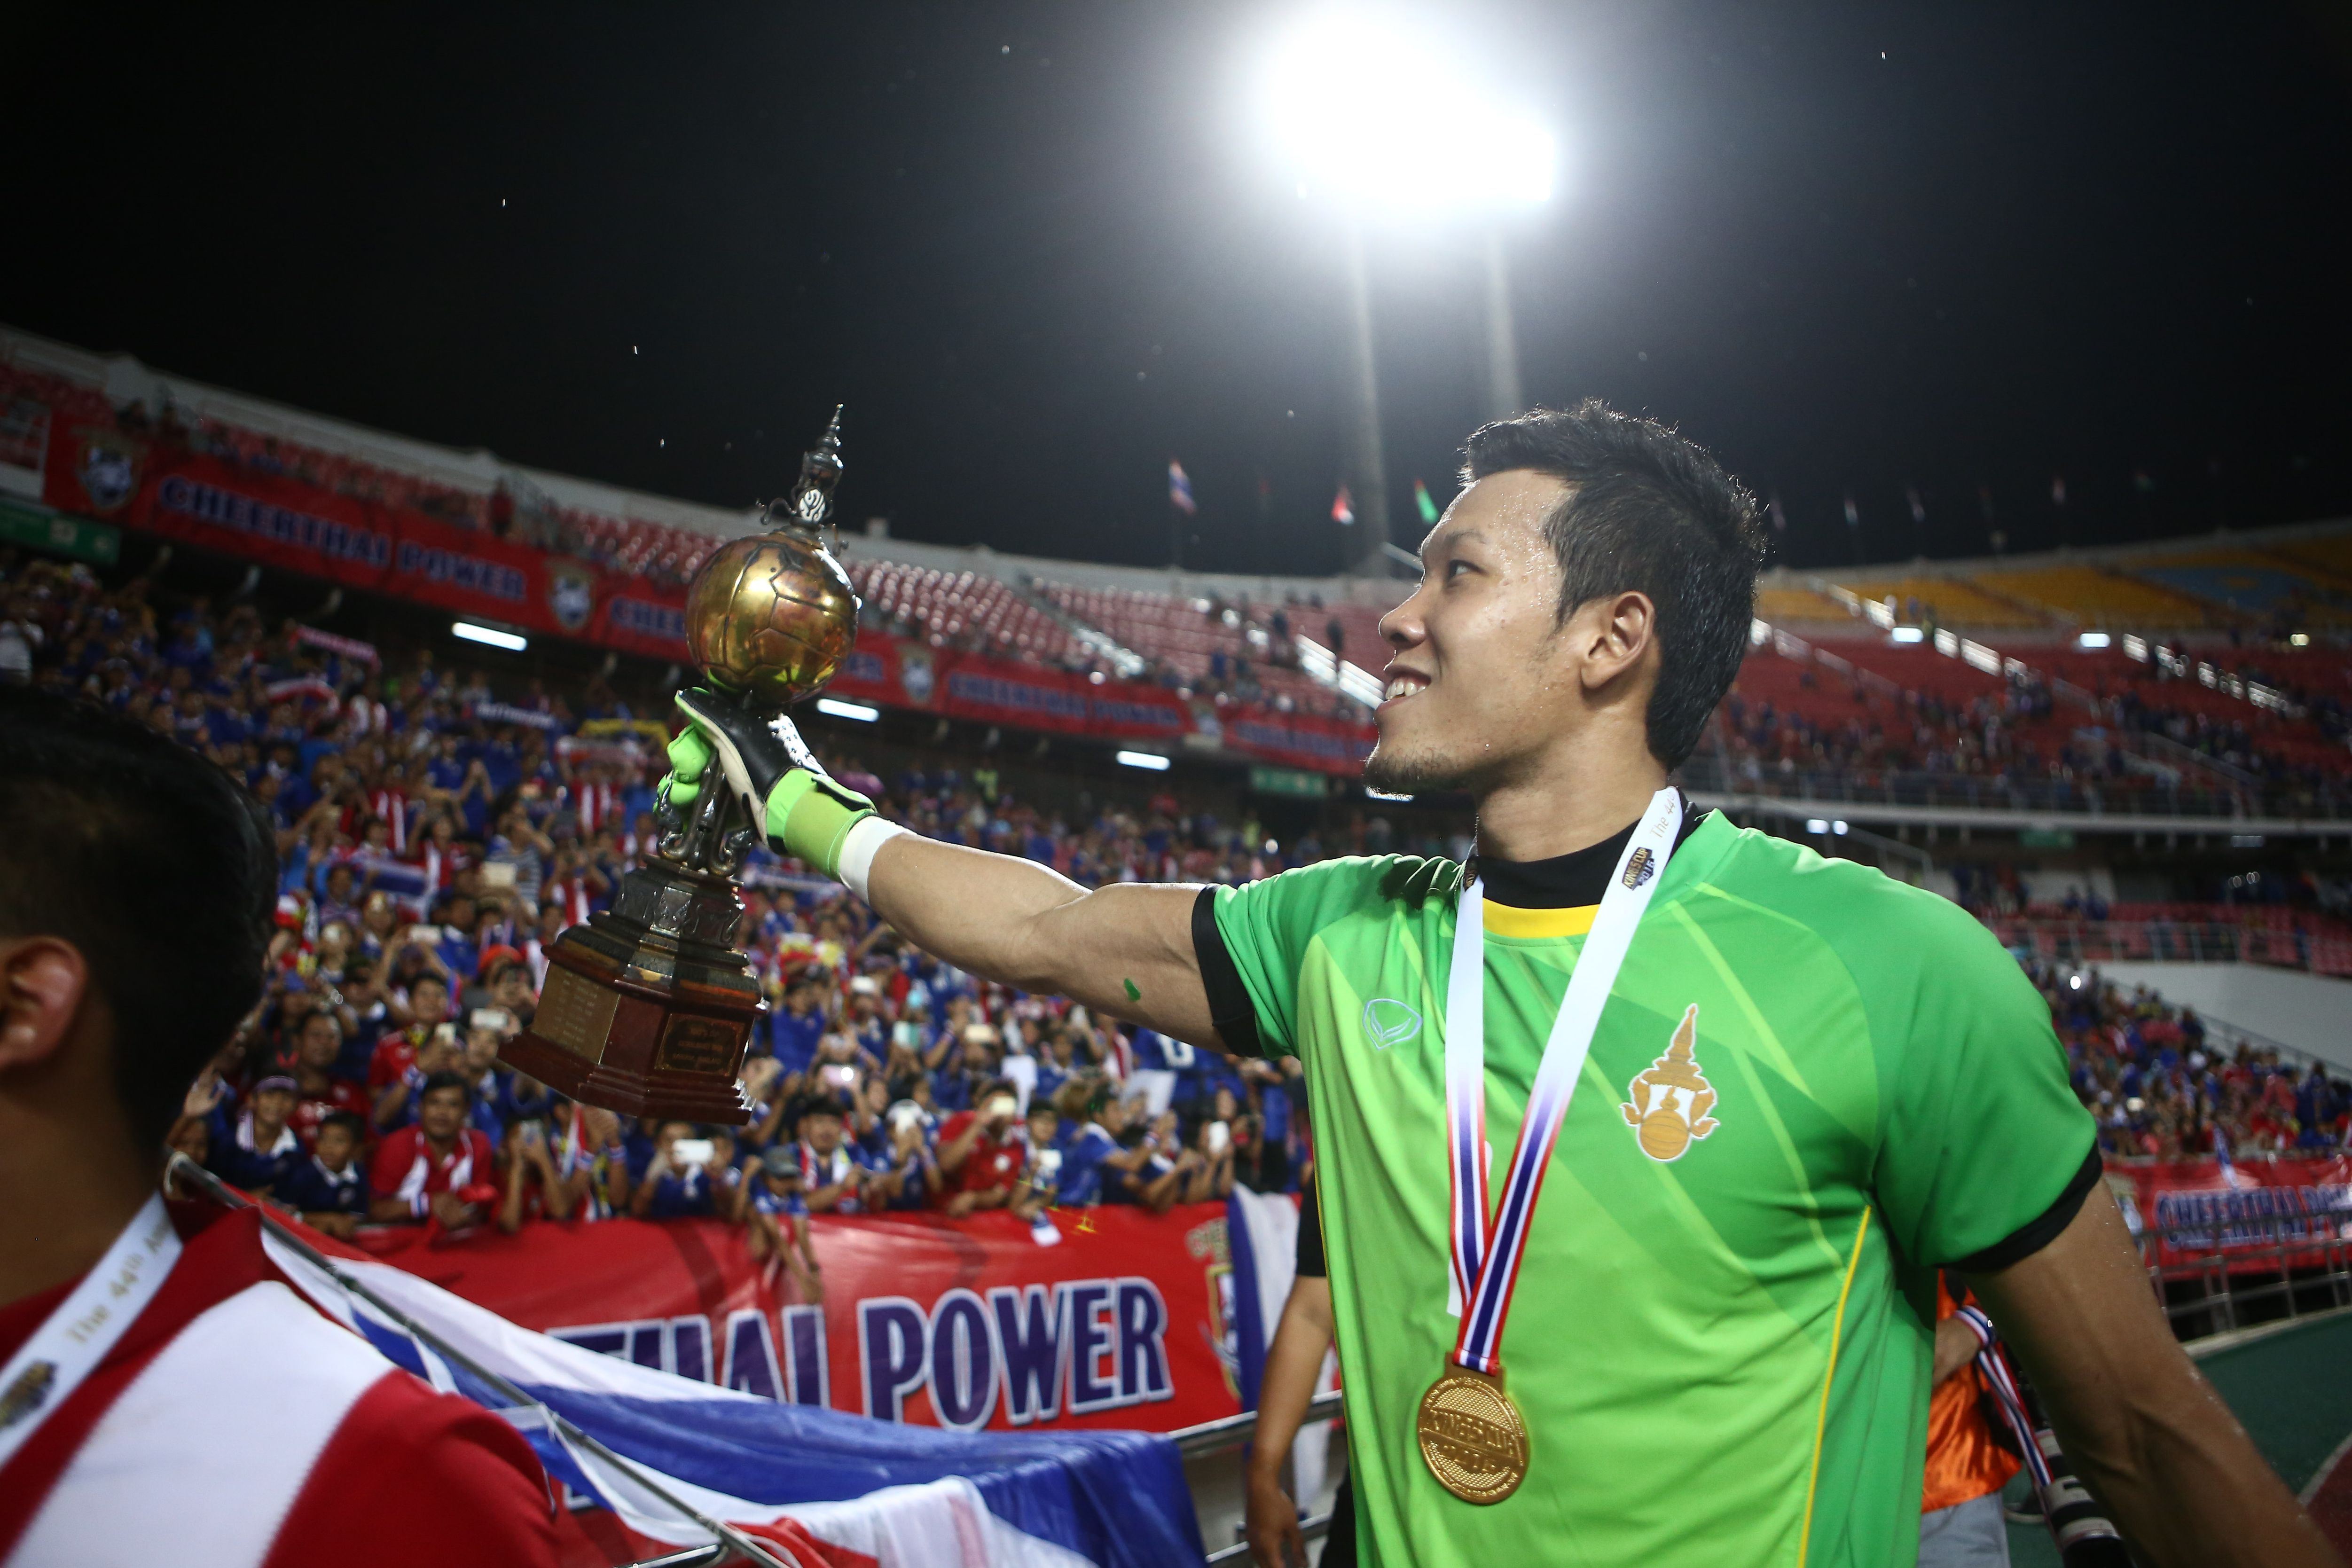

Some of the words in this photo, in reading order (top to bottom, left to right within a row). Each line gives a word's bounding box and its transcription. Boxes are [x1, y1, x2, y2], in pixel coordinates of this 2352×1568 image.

[1650, 817, 1669, 838] The
[545, 1303, 830, 1409] AI
[857, 1277, 1174, 1435] POWER
